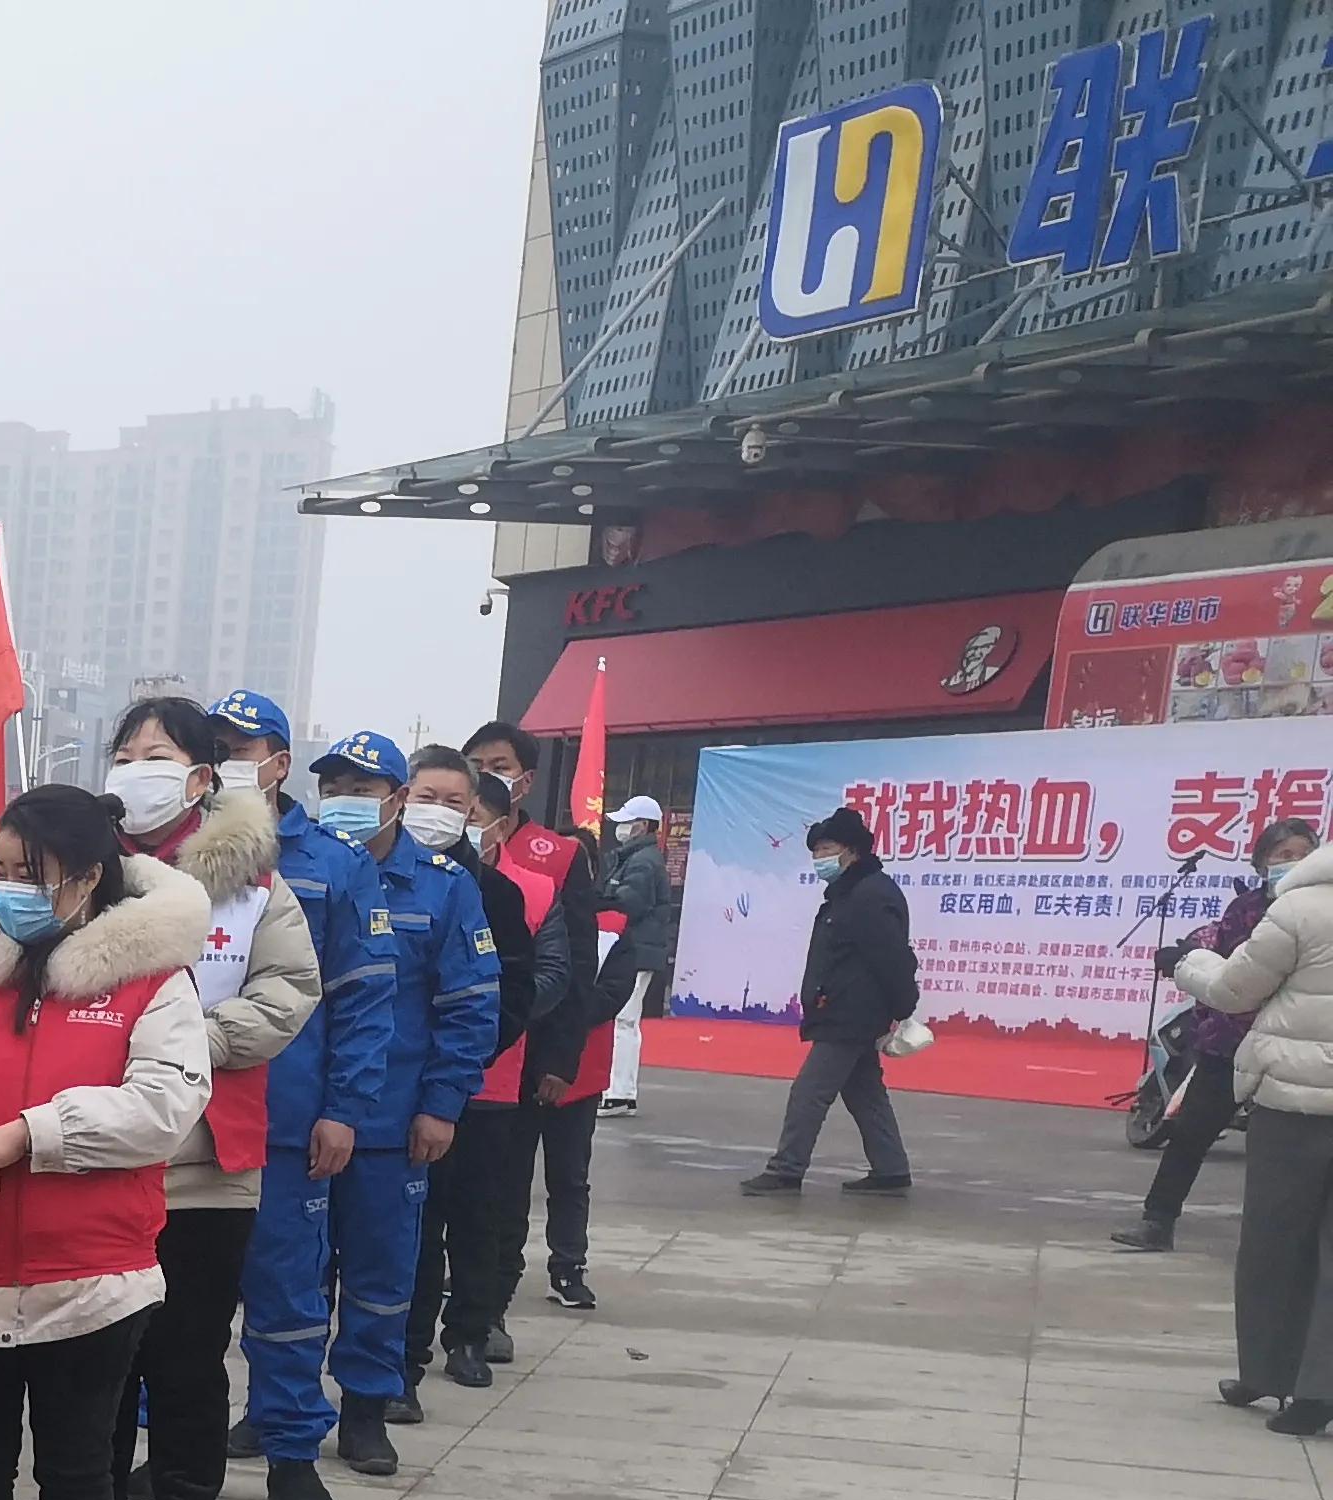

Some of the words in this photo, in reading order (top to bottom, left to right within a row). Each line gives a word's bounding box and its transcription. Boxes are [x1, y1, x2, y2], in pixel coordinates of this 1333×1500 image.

[1008, 14, 1333, 278] 联
[565, 583, 646, 625] KFC
[1118, 596, 1222, 630] 联华超市
